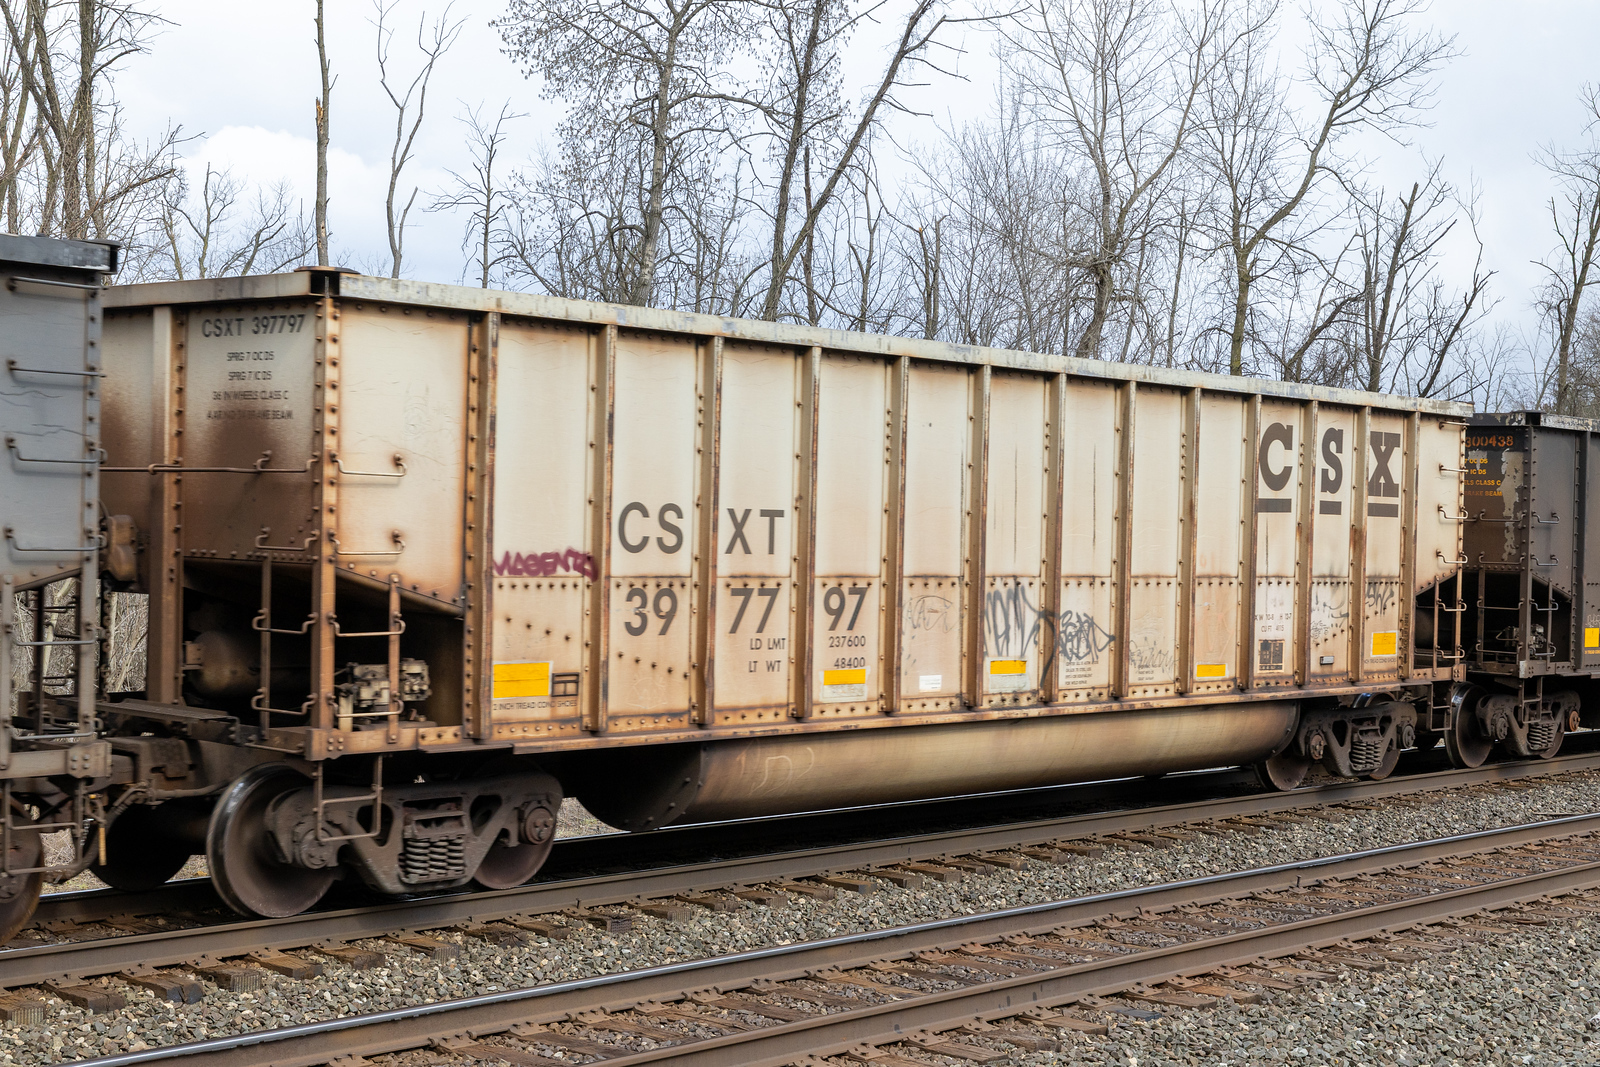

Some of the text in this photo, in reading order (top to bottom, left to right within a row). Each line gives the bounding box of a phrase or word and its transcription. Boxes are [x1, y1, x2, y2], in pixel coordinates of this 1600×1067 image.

[202, 314, 306, 337] CSXT 397797
[260, 390, 282, 400] CLASS
[283, 390, 289, 400] C
[1465, 435, 1514, 448] 300438
[749, 635, 866, 650] LD LMT 237600
[748, 657, 866, 673] LT WT 48400
[499, 702, 514, 711] INCH
[516, 701, 536, 710] TREAD
